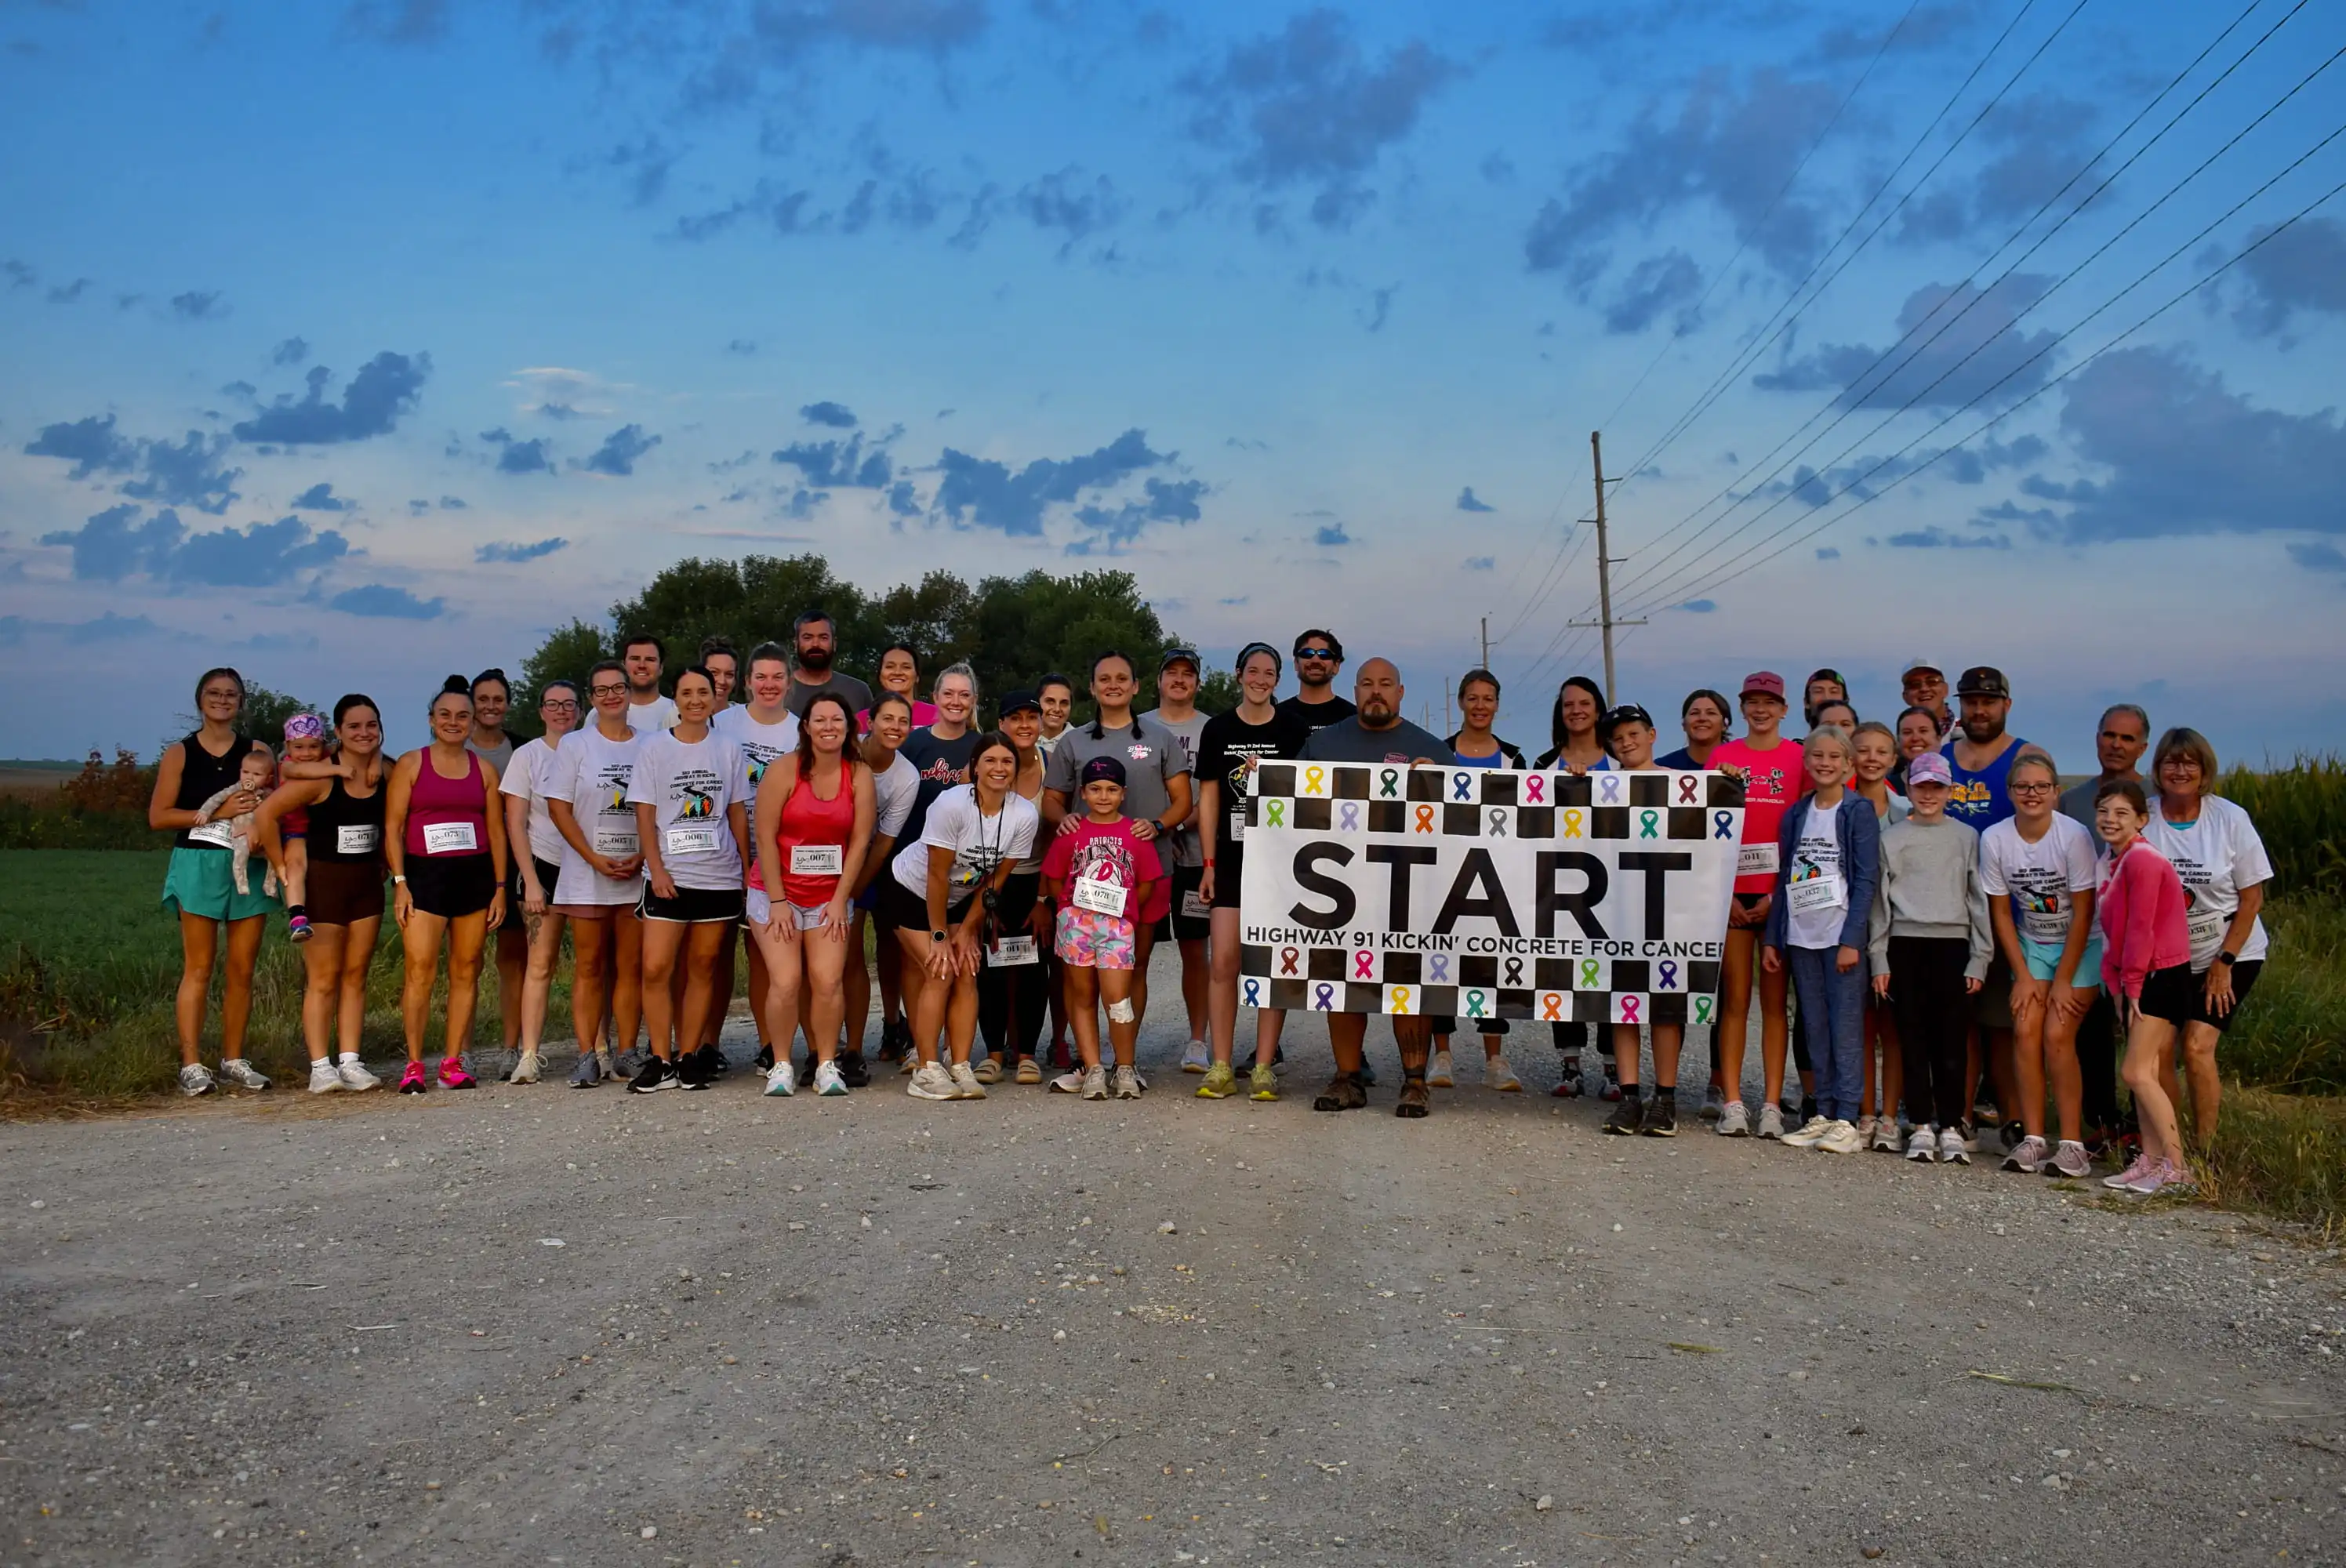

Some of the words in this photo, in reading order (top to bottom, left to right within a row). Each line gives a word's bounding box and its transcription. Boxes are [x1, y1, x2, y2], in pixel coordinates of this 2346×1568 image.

[1089, 836, 1123, 846] PATRIOTS
[809, 853, 826, 862] 007
[1287, 840, 1692, 940] START
[1247, 926, 1346, 946] HIGHWAY
[1353, 931, 1374, 947] 91
[1381, 932, 1459, 951] KICKIN'
[1466, 936, 1583, 956] CONCRETE
[1590, 940, 1635, 956] FOR
